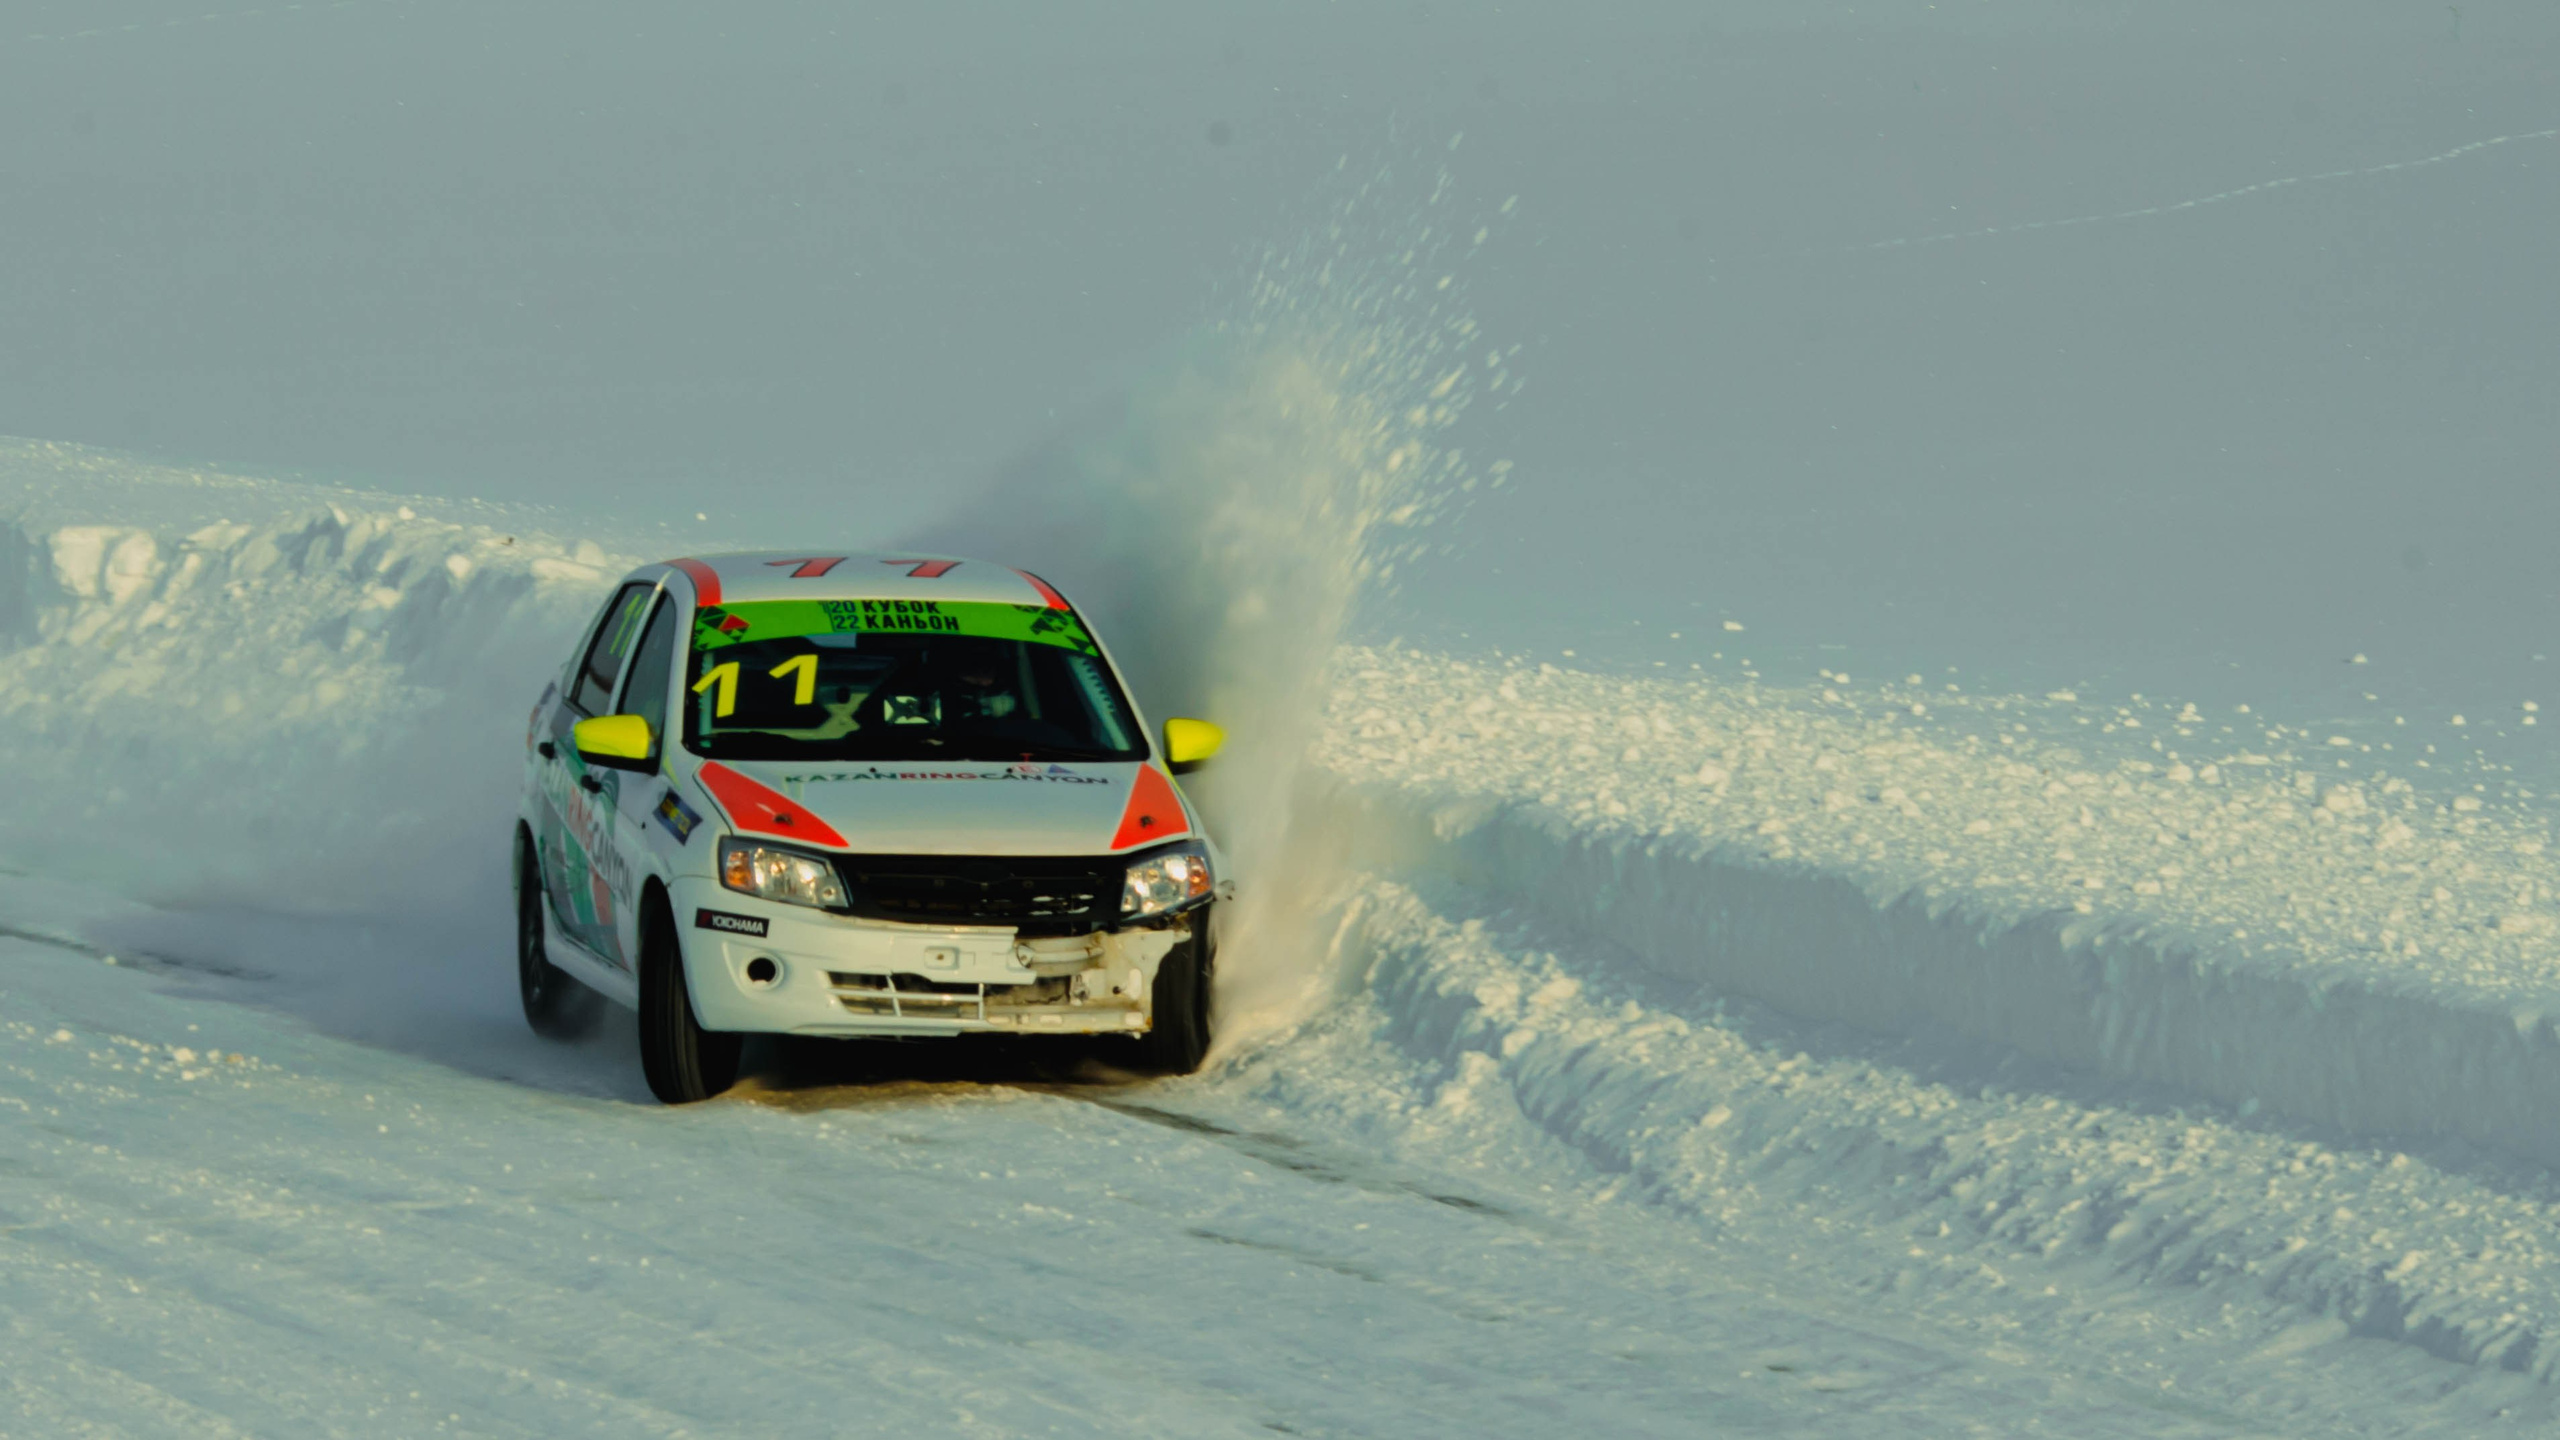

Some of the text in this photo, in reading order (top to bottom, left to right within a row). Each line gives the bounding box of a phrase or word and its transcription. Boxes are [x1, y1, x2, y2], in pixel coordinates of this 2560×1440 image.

[829, 600, 941, 614] 20 КУБОК
[833, 614, 960, 631] 22 КАНЬОН
[712, 914, 764, 934] YOKOHAMA
